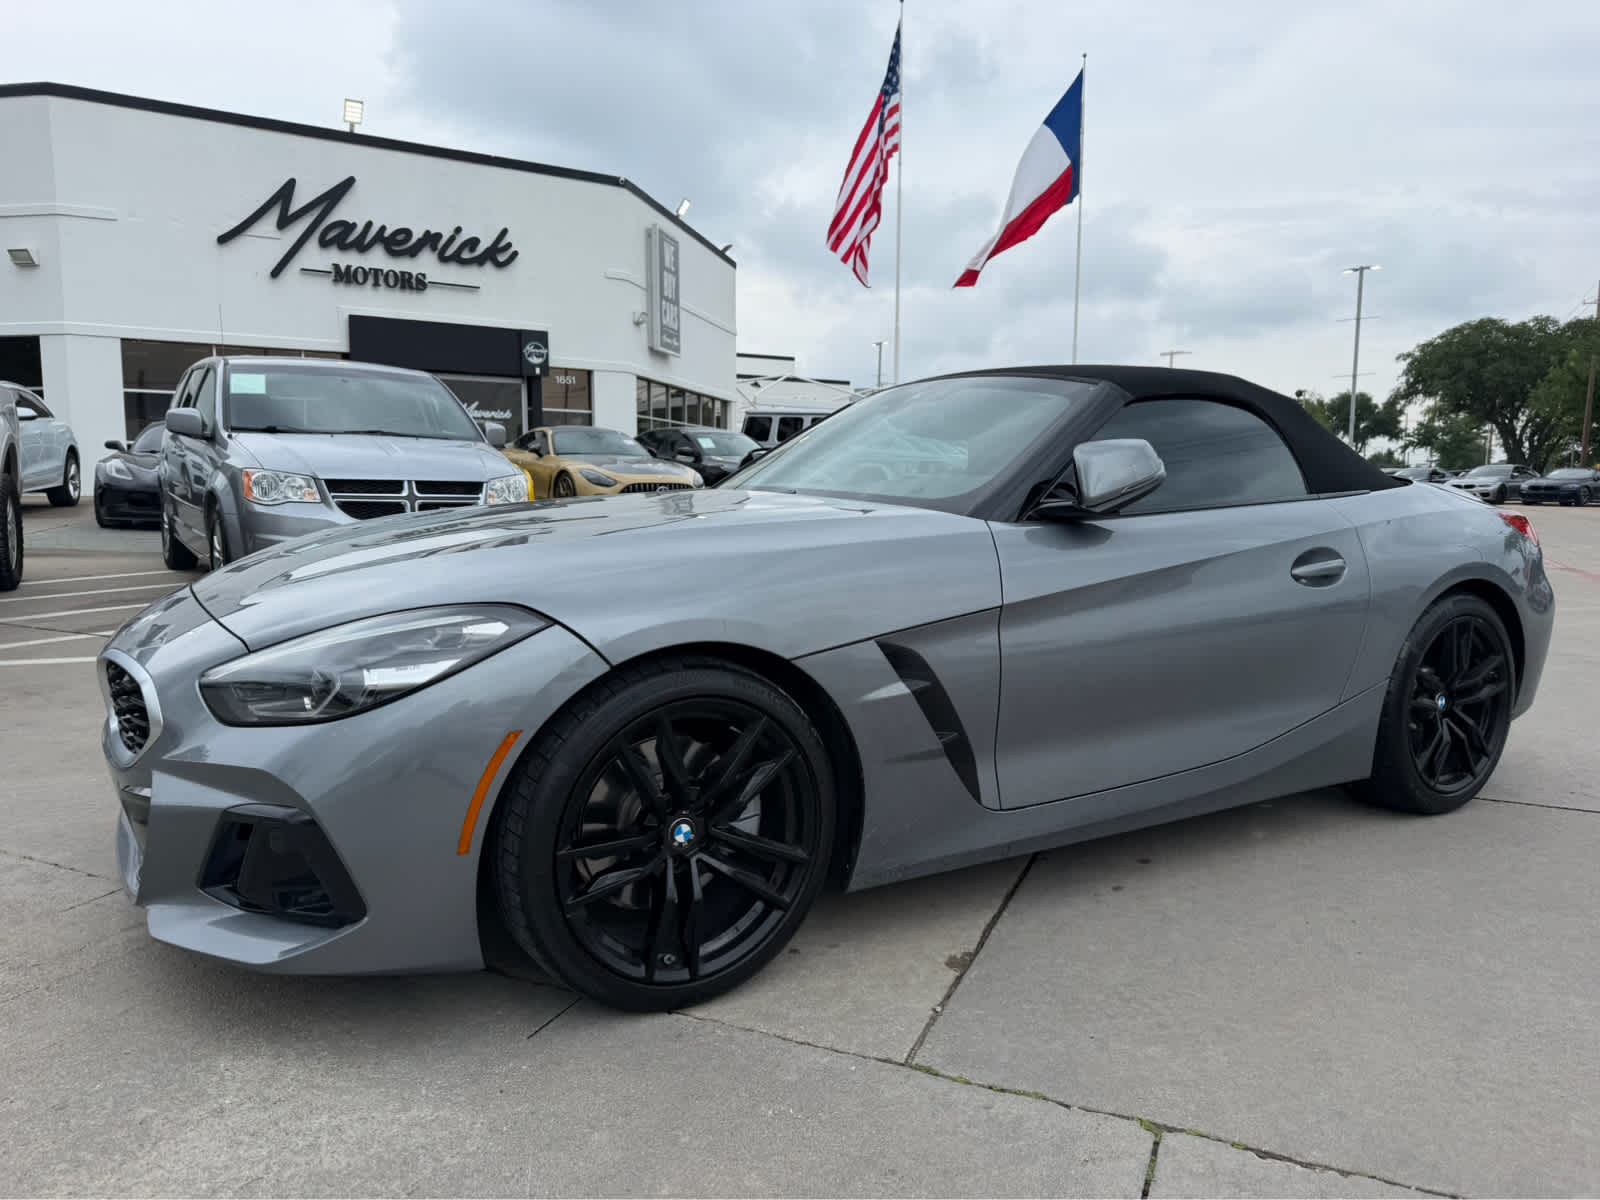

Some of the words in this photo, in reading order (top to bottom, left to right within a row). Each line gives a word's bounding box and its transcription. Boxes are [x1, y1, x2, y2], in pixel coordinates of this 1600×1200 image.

[217, 175, 519, 278] Maverick
[332, 263, 428, 291] MOTORS
[554, 375, 576, 385] 1651
